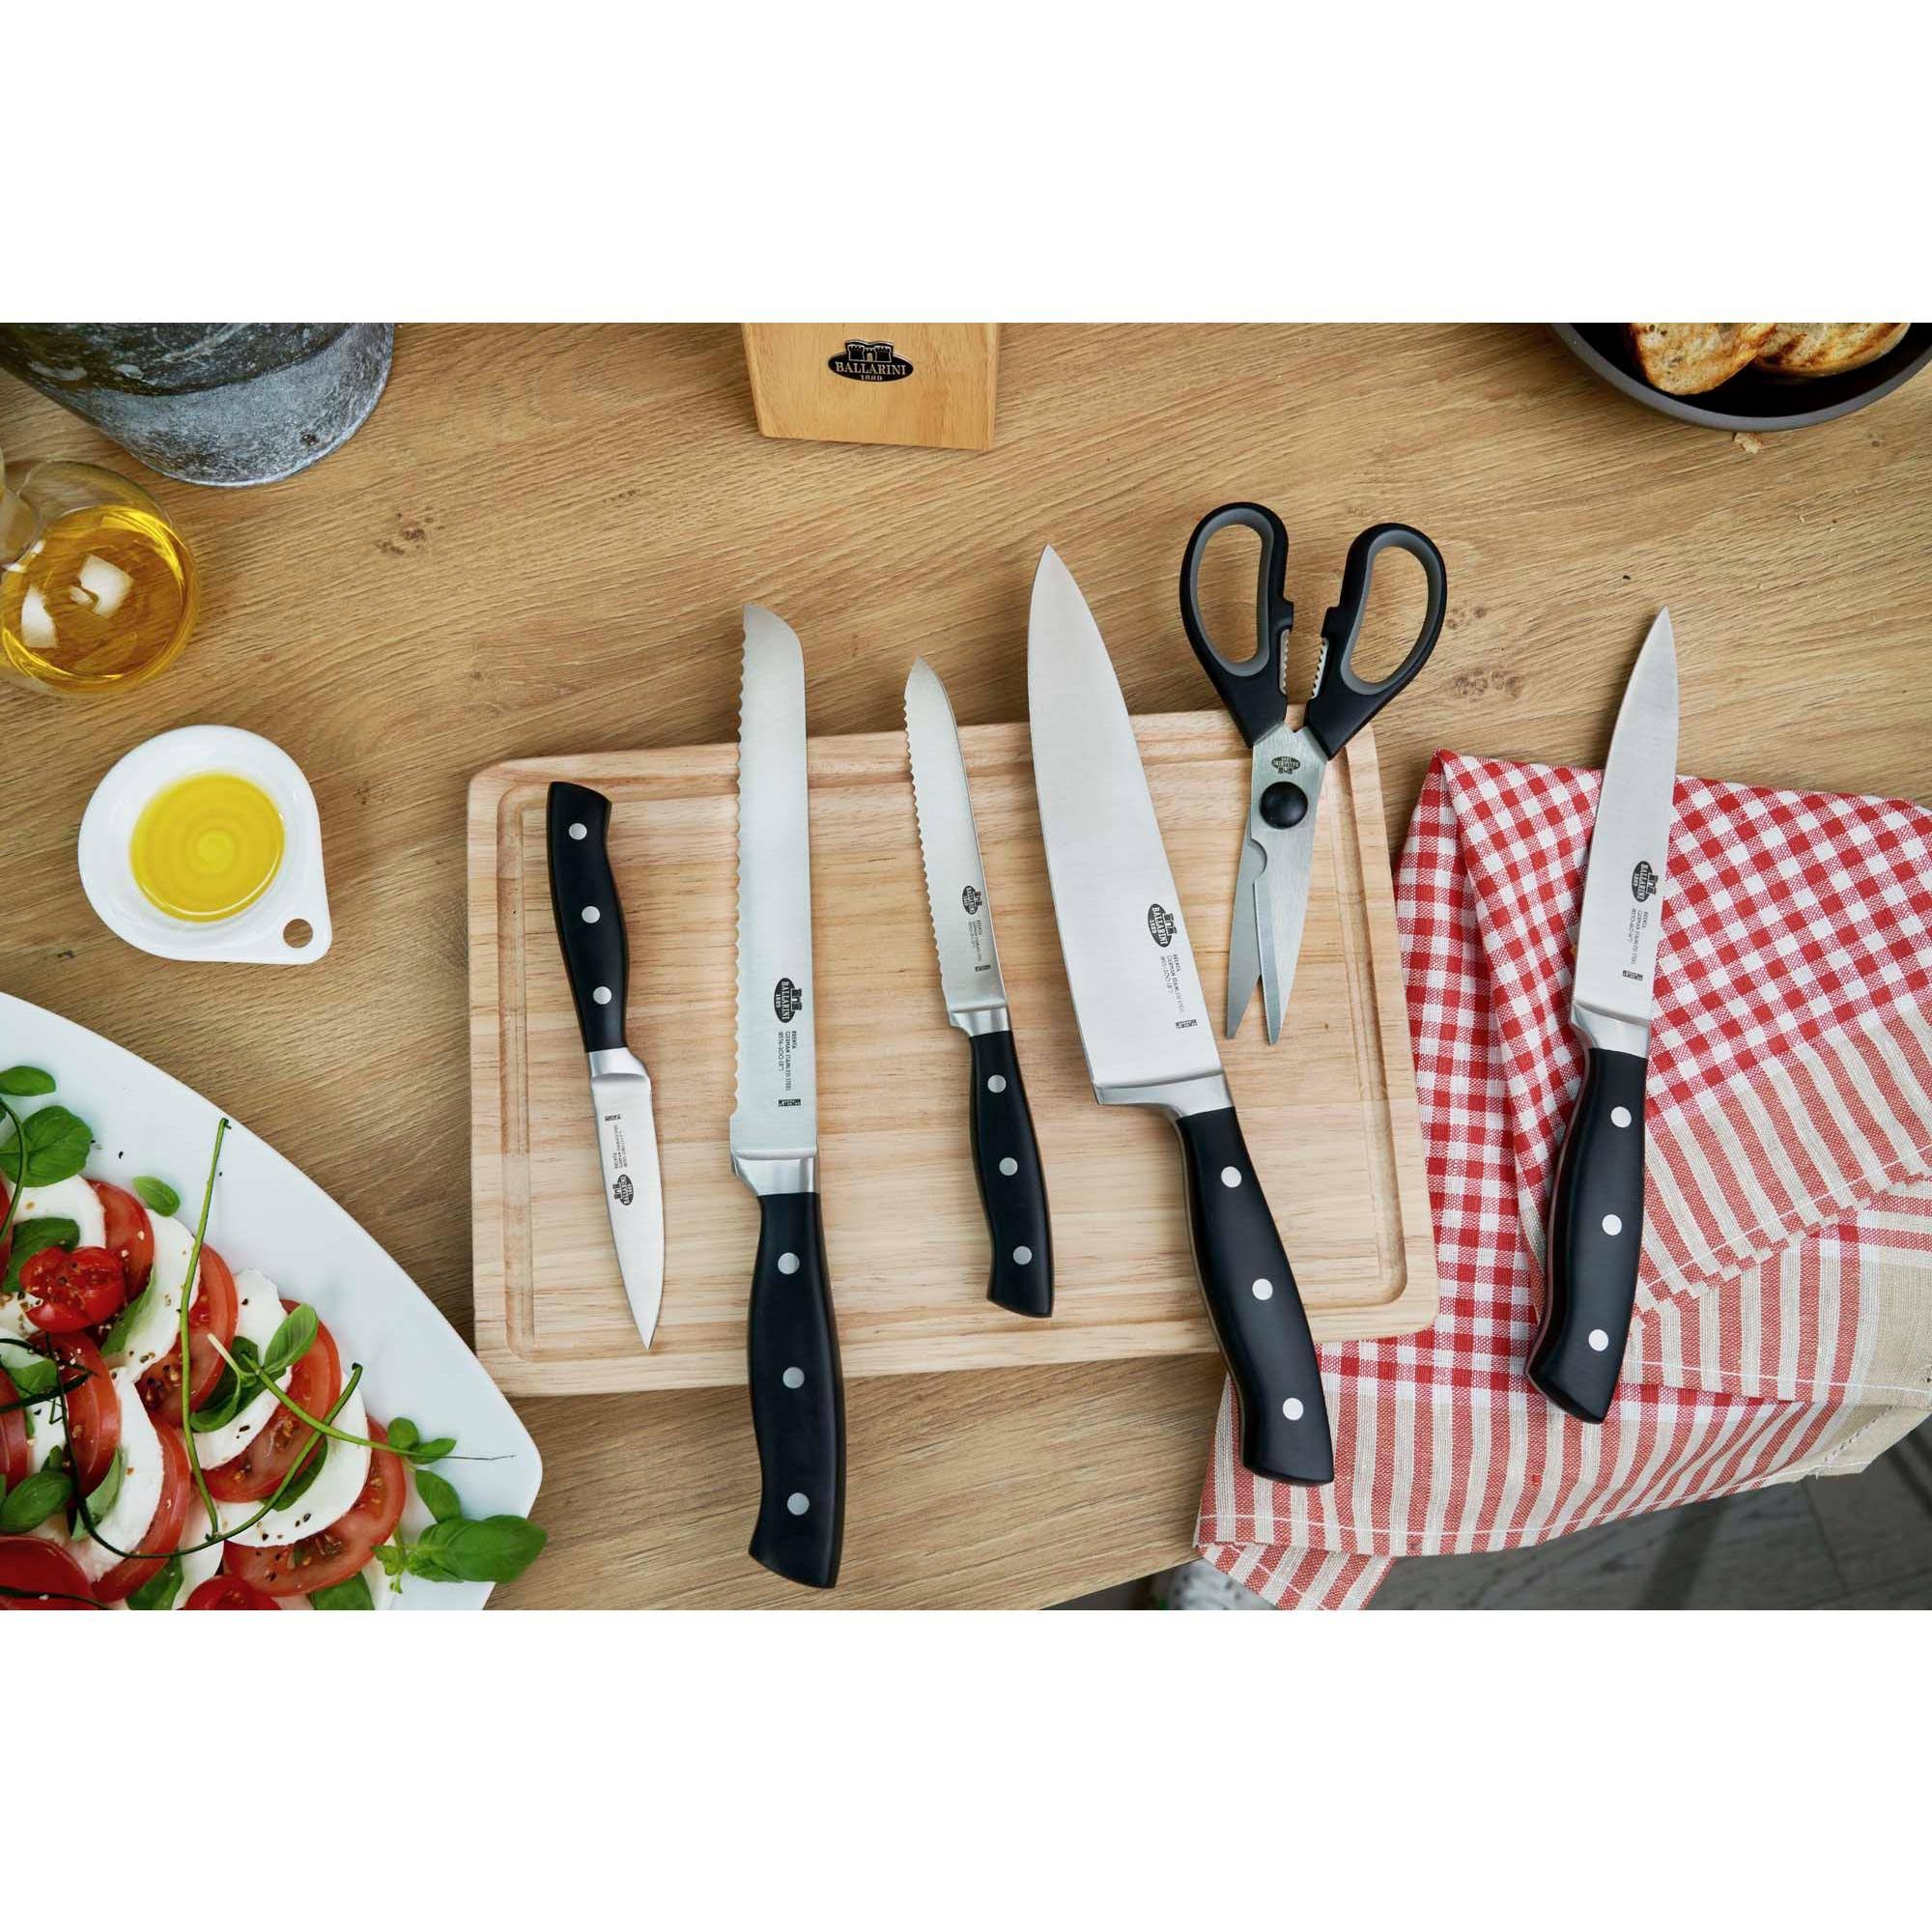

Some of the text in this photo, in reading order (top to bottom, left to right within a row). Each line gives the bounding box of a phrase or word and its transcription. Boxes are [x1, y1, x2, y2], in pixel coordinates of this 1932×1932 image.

[836, 361, 906, 375] BALLARINI
[1636, 864, 1648, 899] BALLARINI
[1151, 905, 1168, 944] BALLARINI
[781, 981, 790, 1019] BALLARINI
